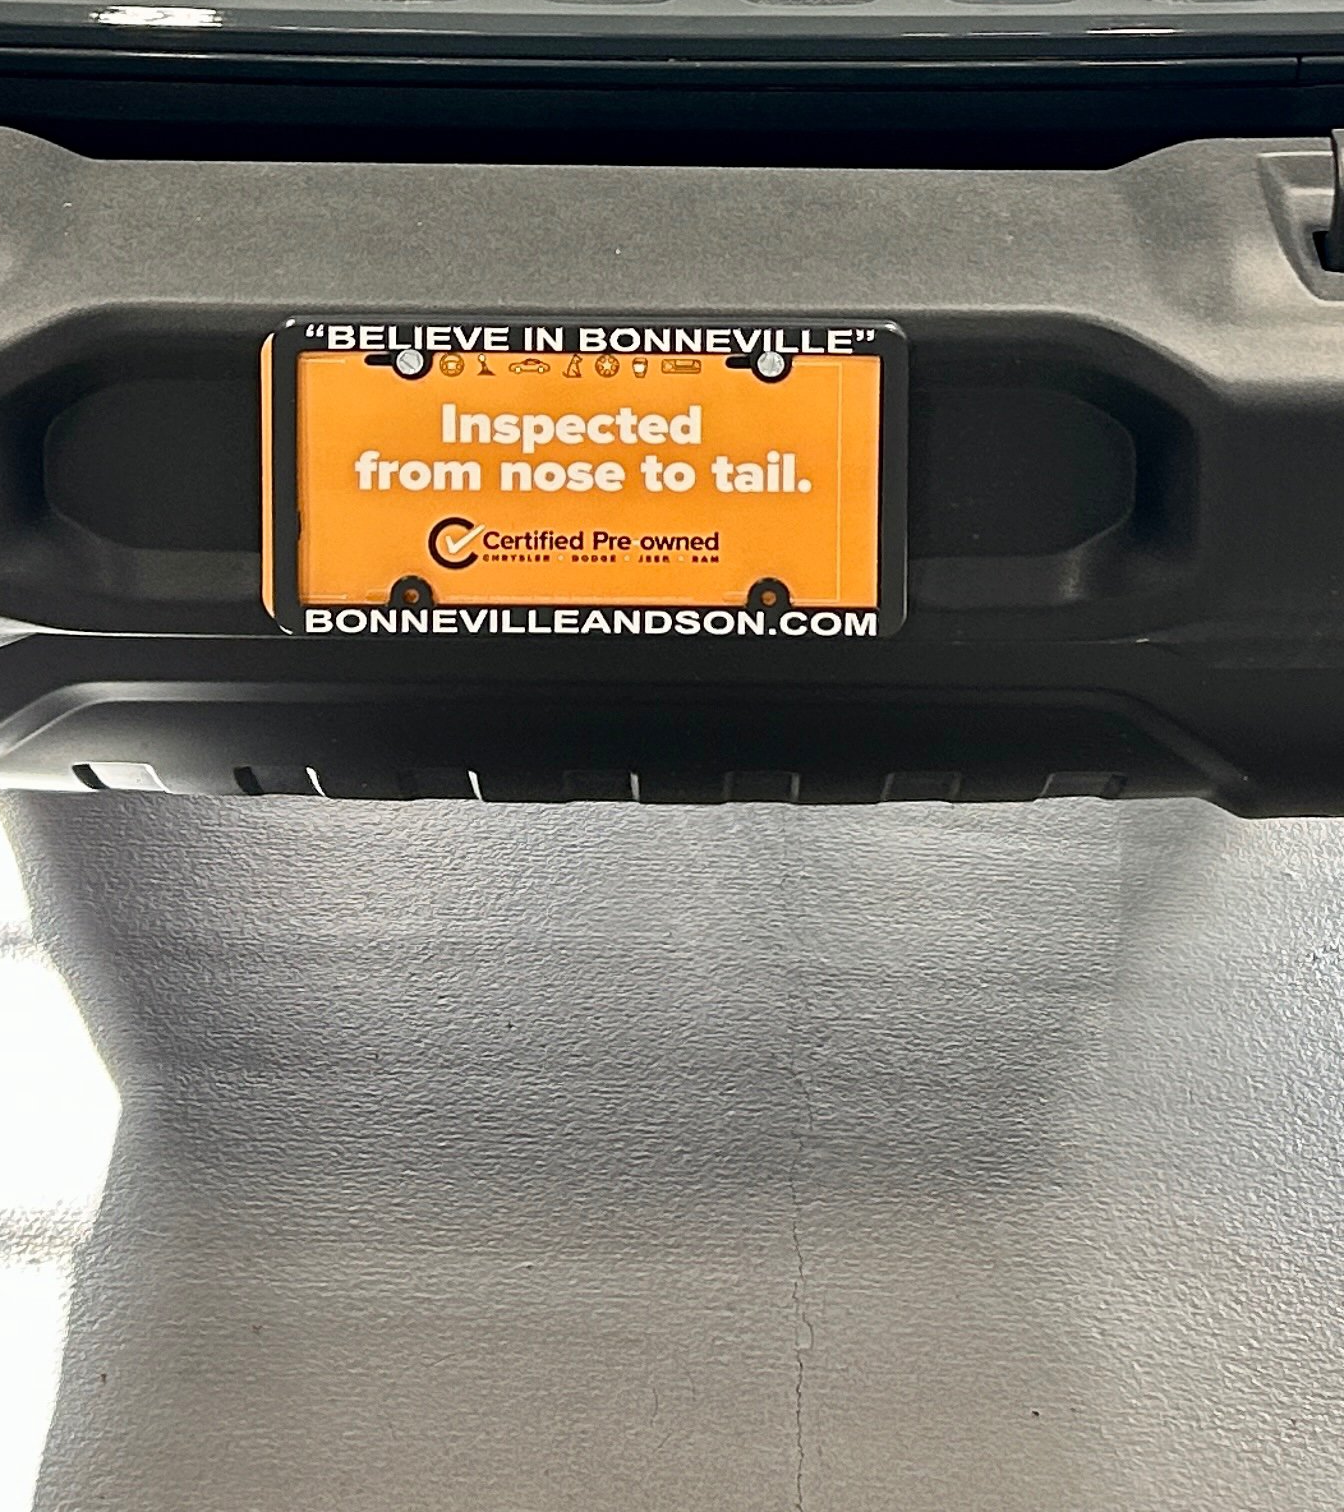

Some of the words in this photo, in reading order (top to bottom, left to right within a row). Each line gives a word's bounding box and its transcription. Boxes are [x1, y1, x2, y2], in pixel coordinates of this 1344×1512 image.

[524, 326, 563, 352] IN
[441, 403, 702, 455] Inspected
[354, 450, 481, 492] from
[500, 460, 626, 493] nose
[640, 455, 696, 493] to
[711, 450, 812, 494] tail.
[482, 530, 584, 550] Certified
[305, 609, 879, 637] BONNEVILLEANDSON.COM
